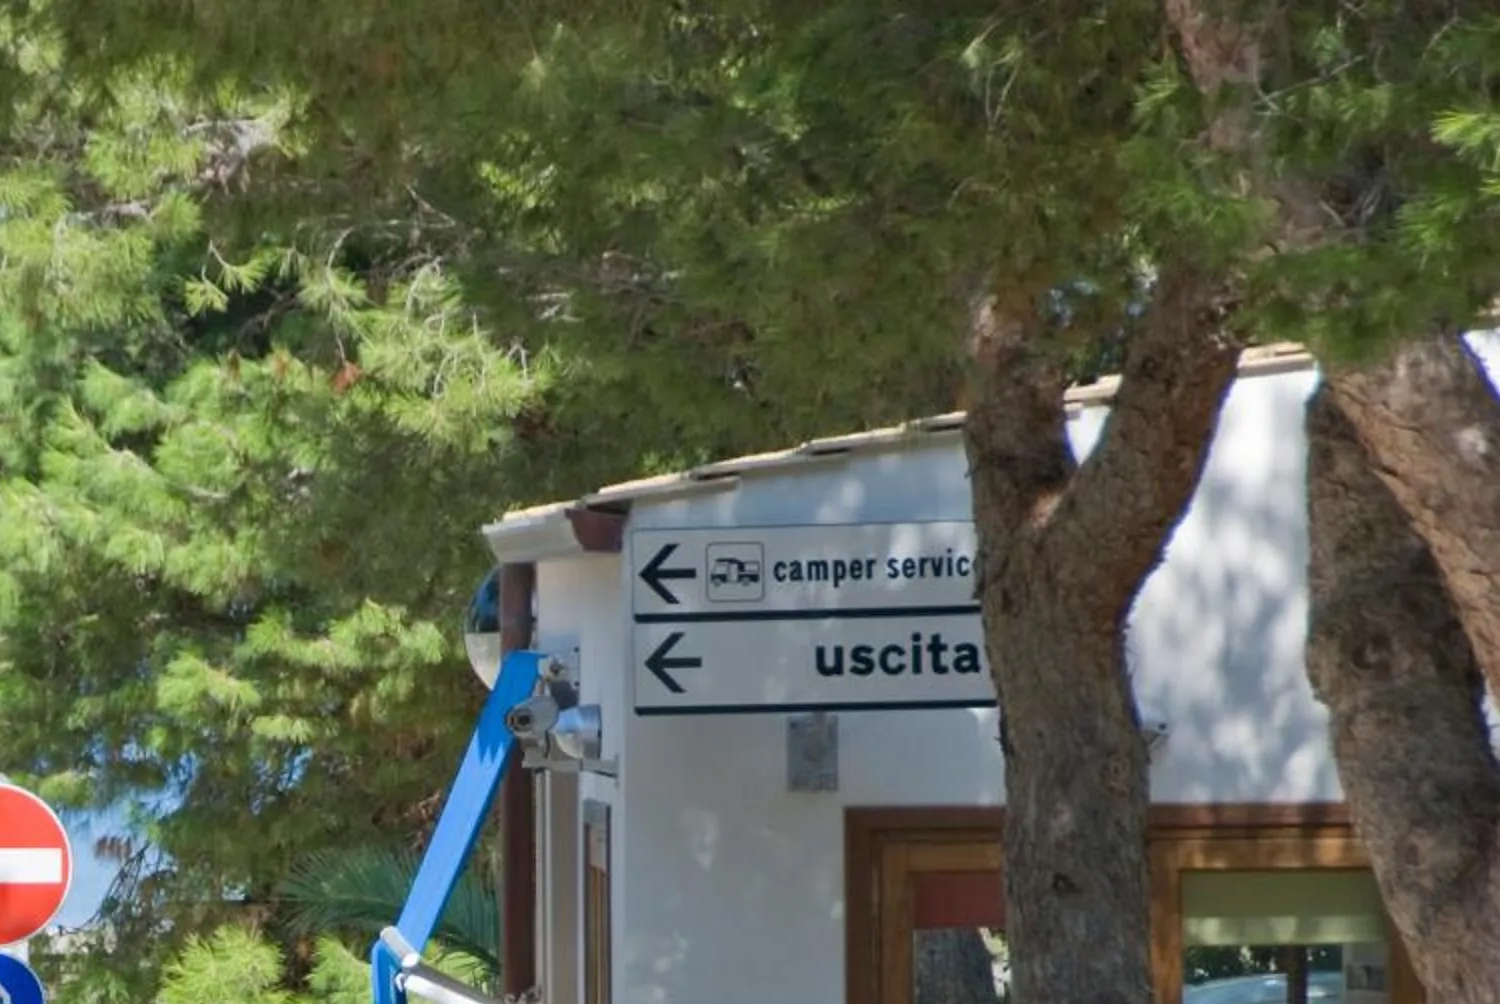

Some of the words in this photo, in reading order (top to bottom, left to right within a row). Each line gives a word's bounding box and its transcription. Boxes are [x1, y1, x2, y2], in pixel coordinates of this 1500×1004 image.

[773, 557, 877, 588] camper
[887, 547, 973, 578] servic
[815, 633, 981, 677] uscita
